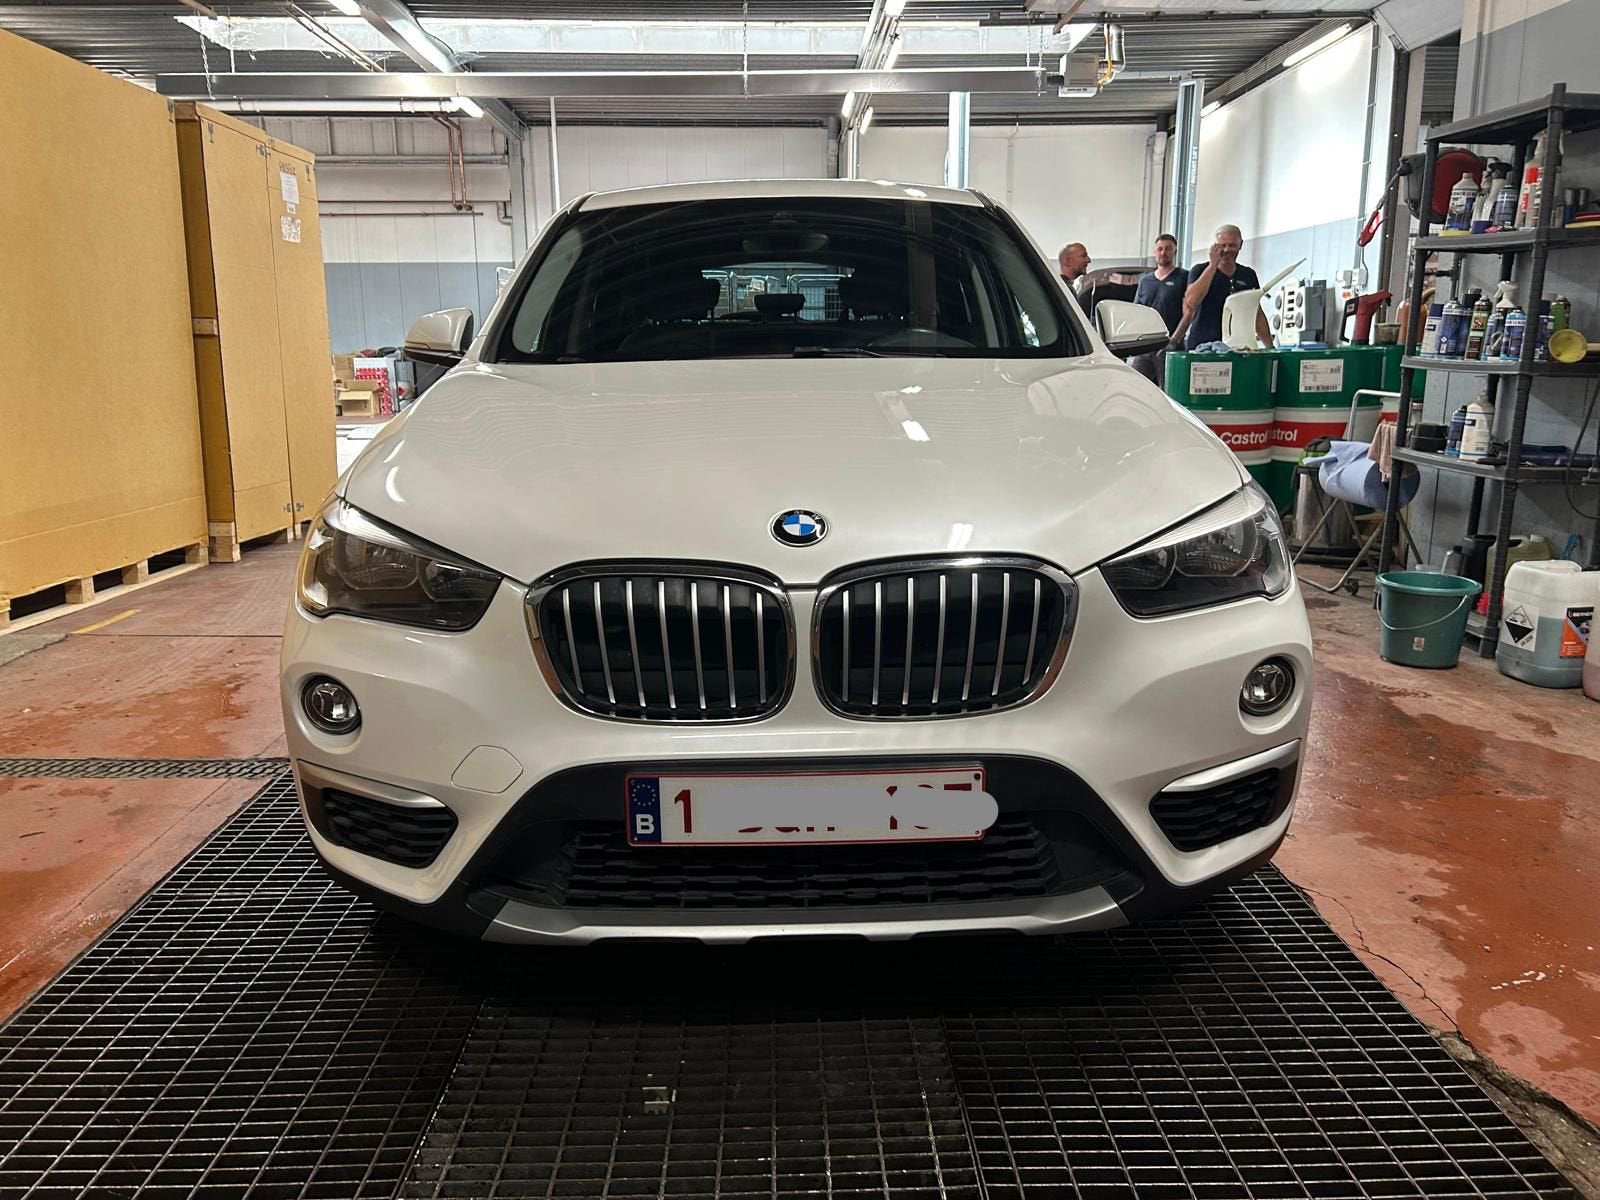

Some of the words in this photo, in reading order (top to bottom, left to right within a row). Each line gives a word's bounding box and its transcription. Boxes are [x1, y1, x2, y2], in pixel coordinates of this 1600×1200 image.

[1220, 430, 1267, 445] Castrol
[1272, 428, 1298, 441] strol
[635, 813, 655, 835] B
